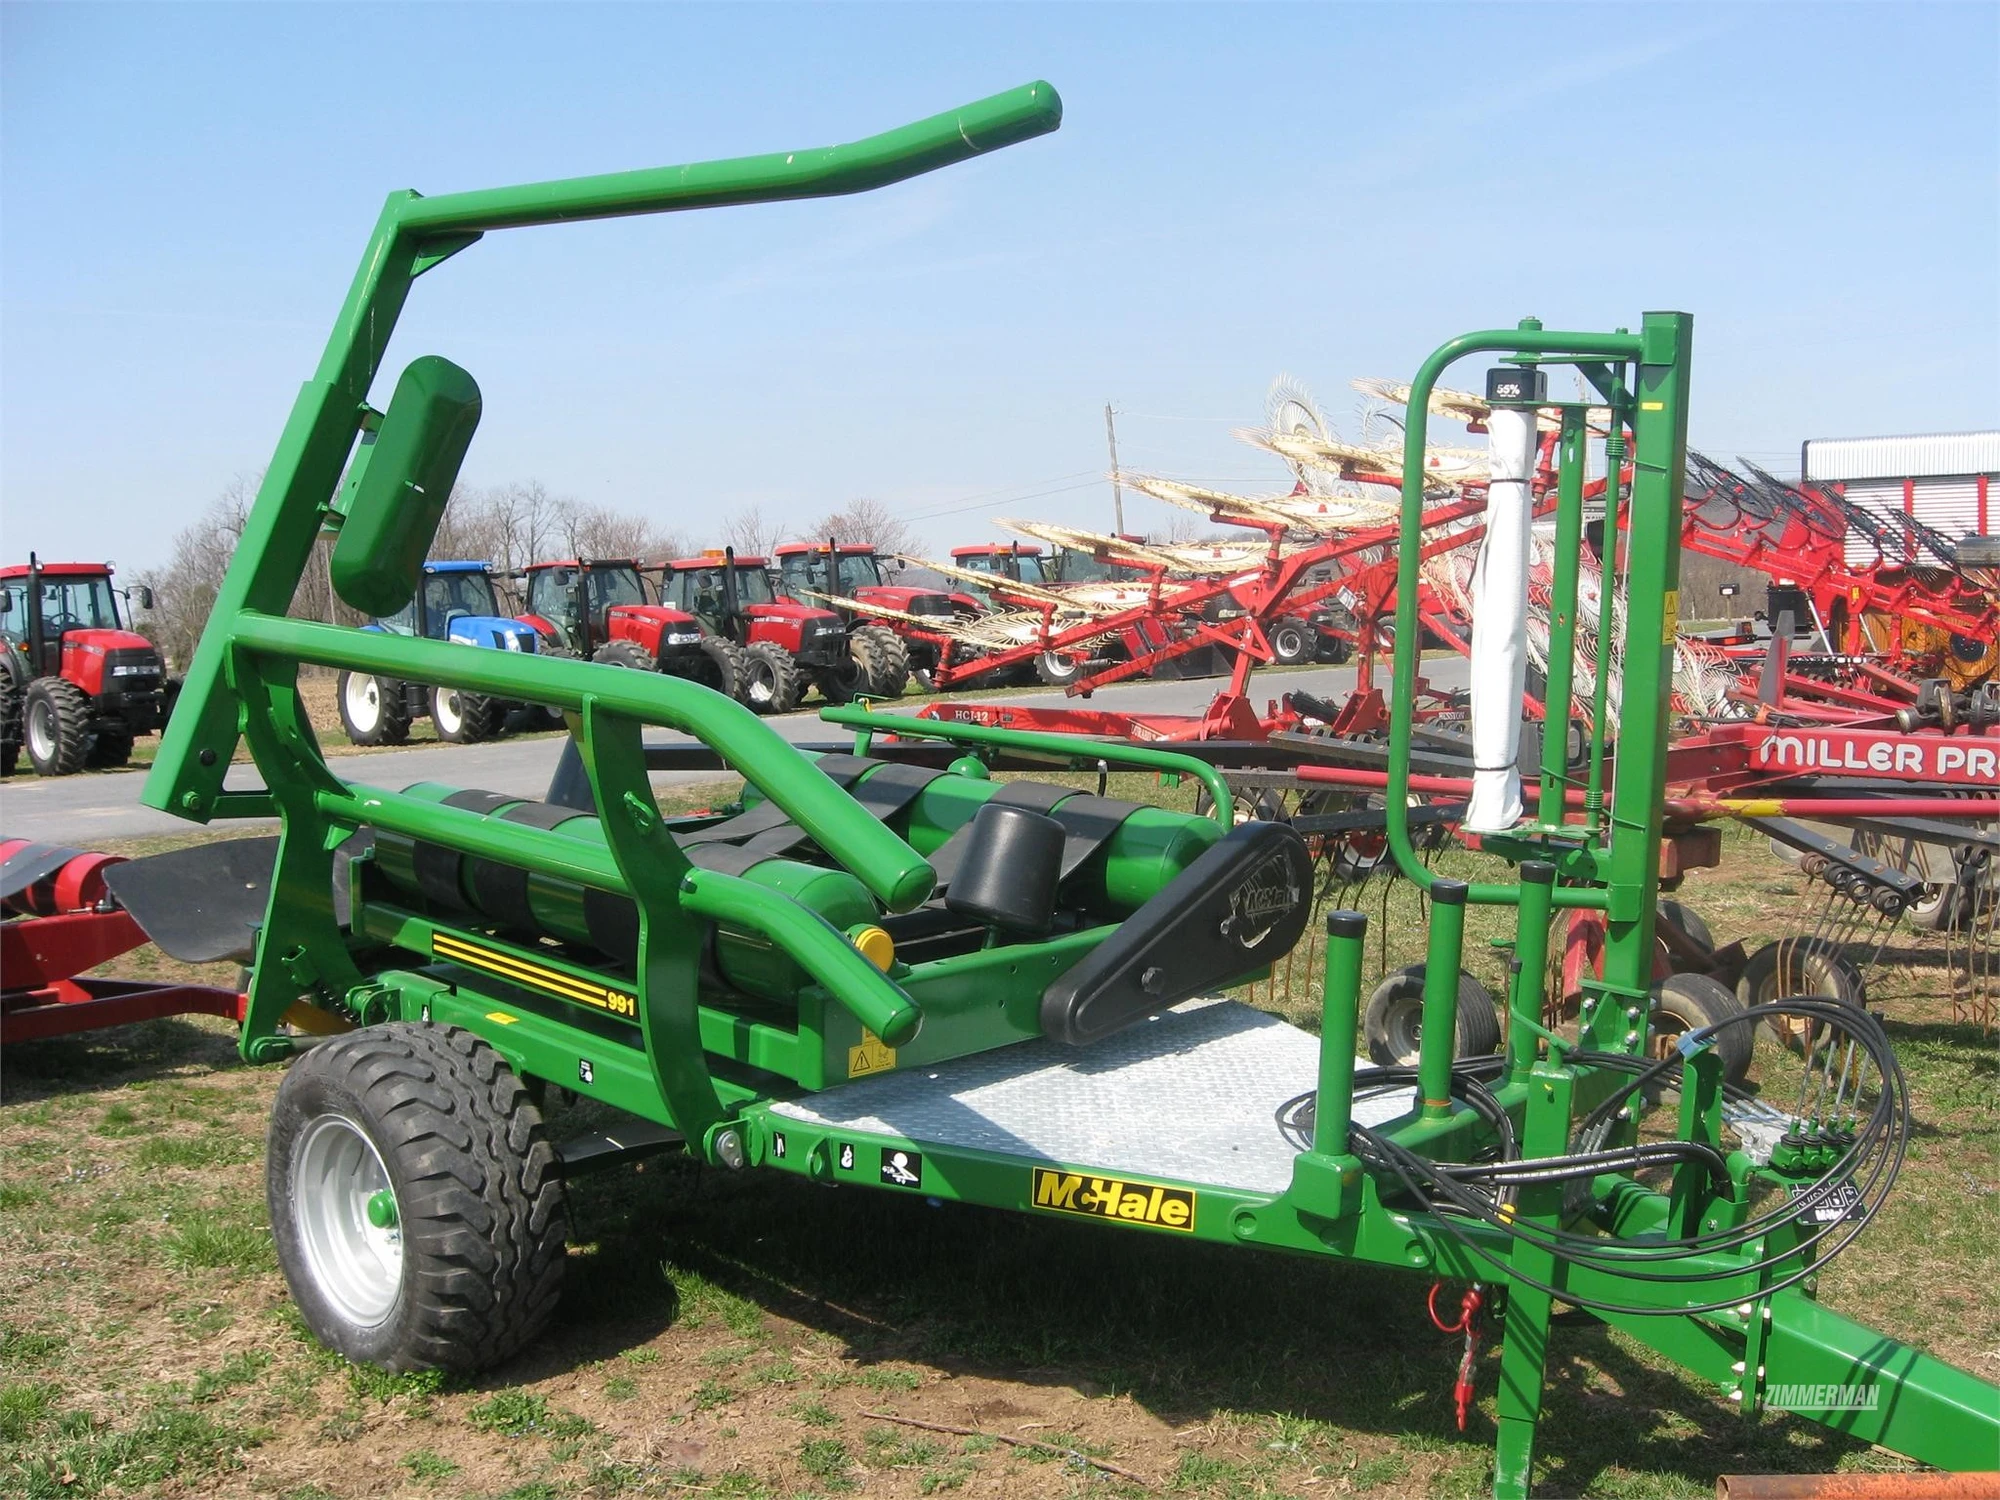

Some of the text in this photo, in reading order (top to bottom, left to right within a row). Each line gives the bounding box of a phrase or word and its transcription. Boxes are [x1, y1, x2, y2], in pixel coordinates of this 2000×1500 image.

[1496, 383, 1520, 395] 55%
[1760, 735, 2000, 779] MILLER PR
[607, 991, 634, 1016] 991
[1036, 1171, 1190, 1226] McHale
